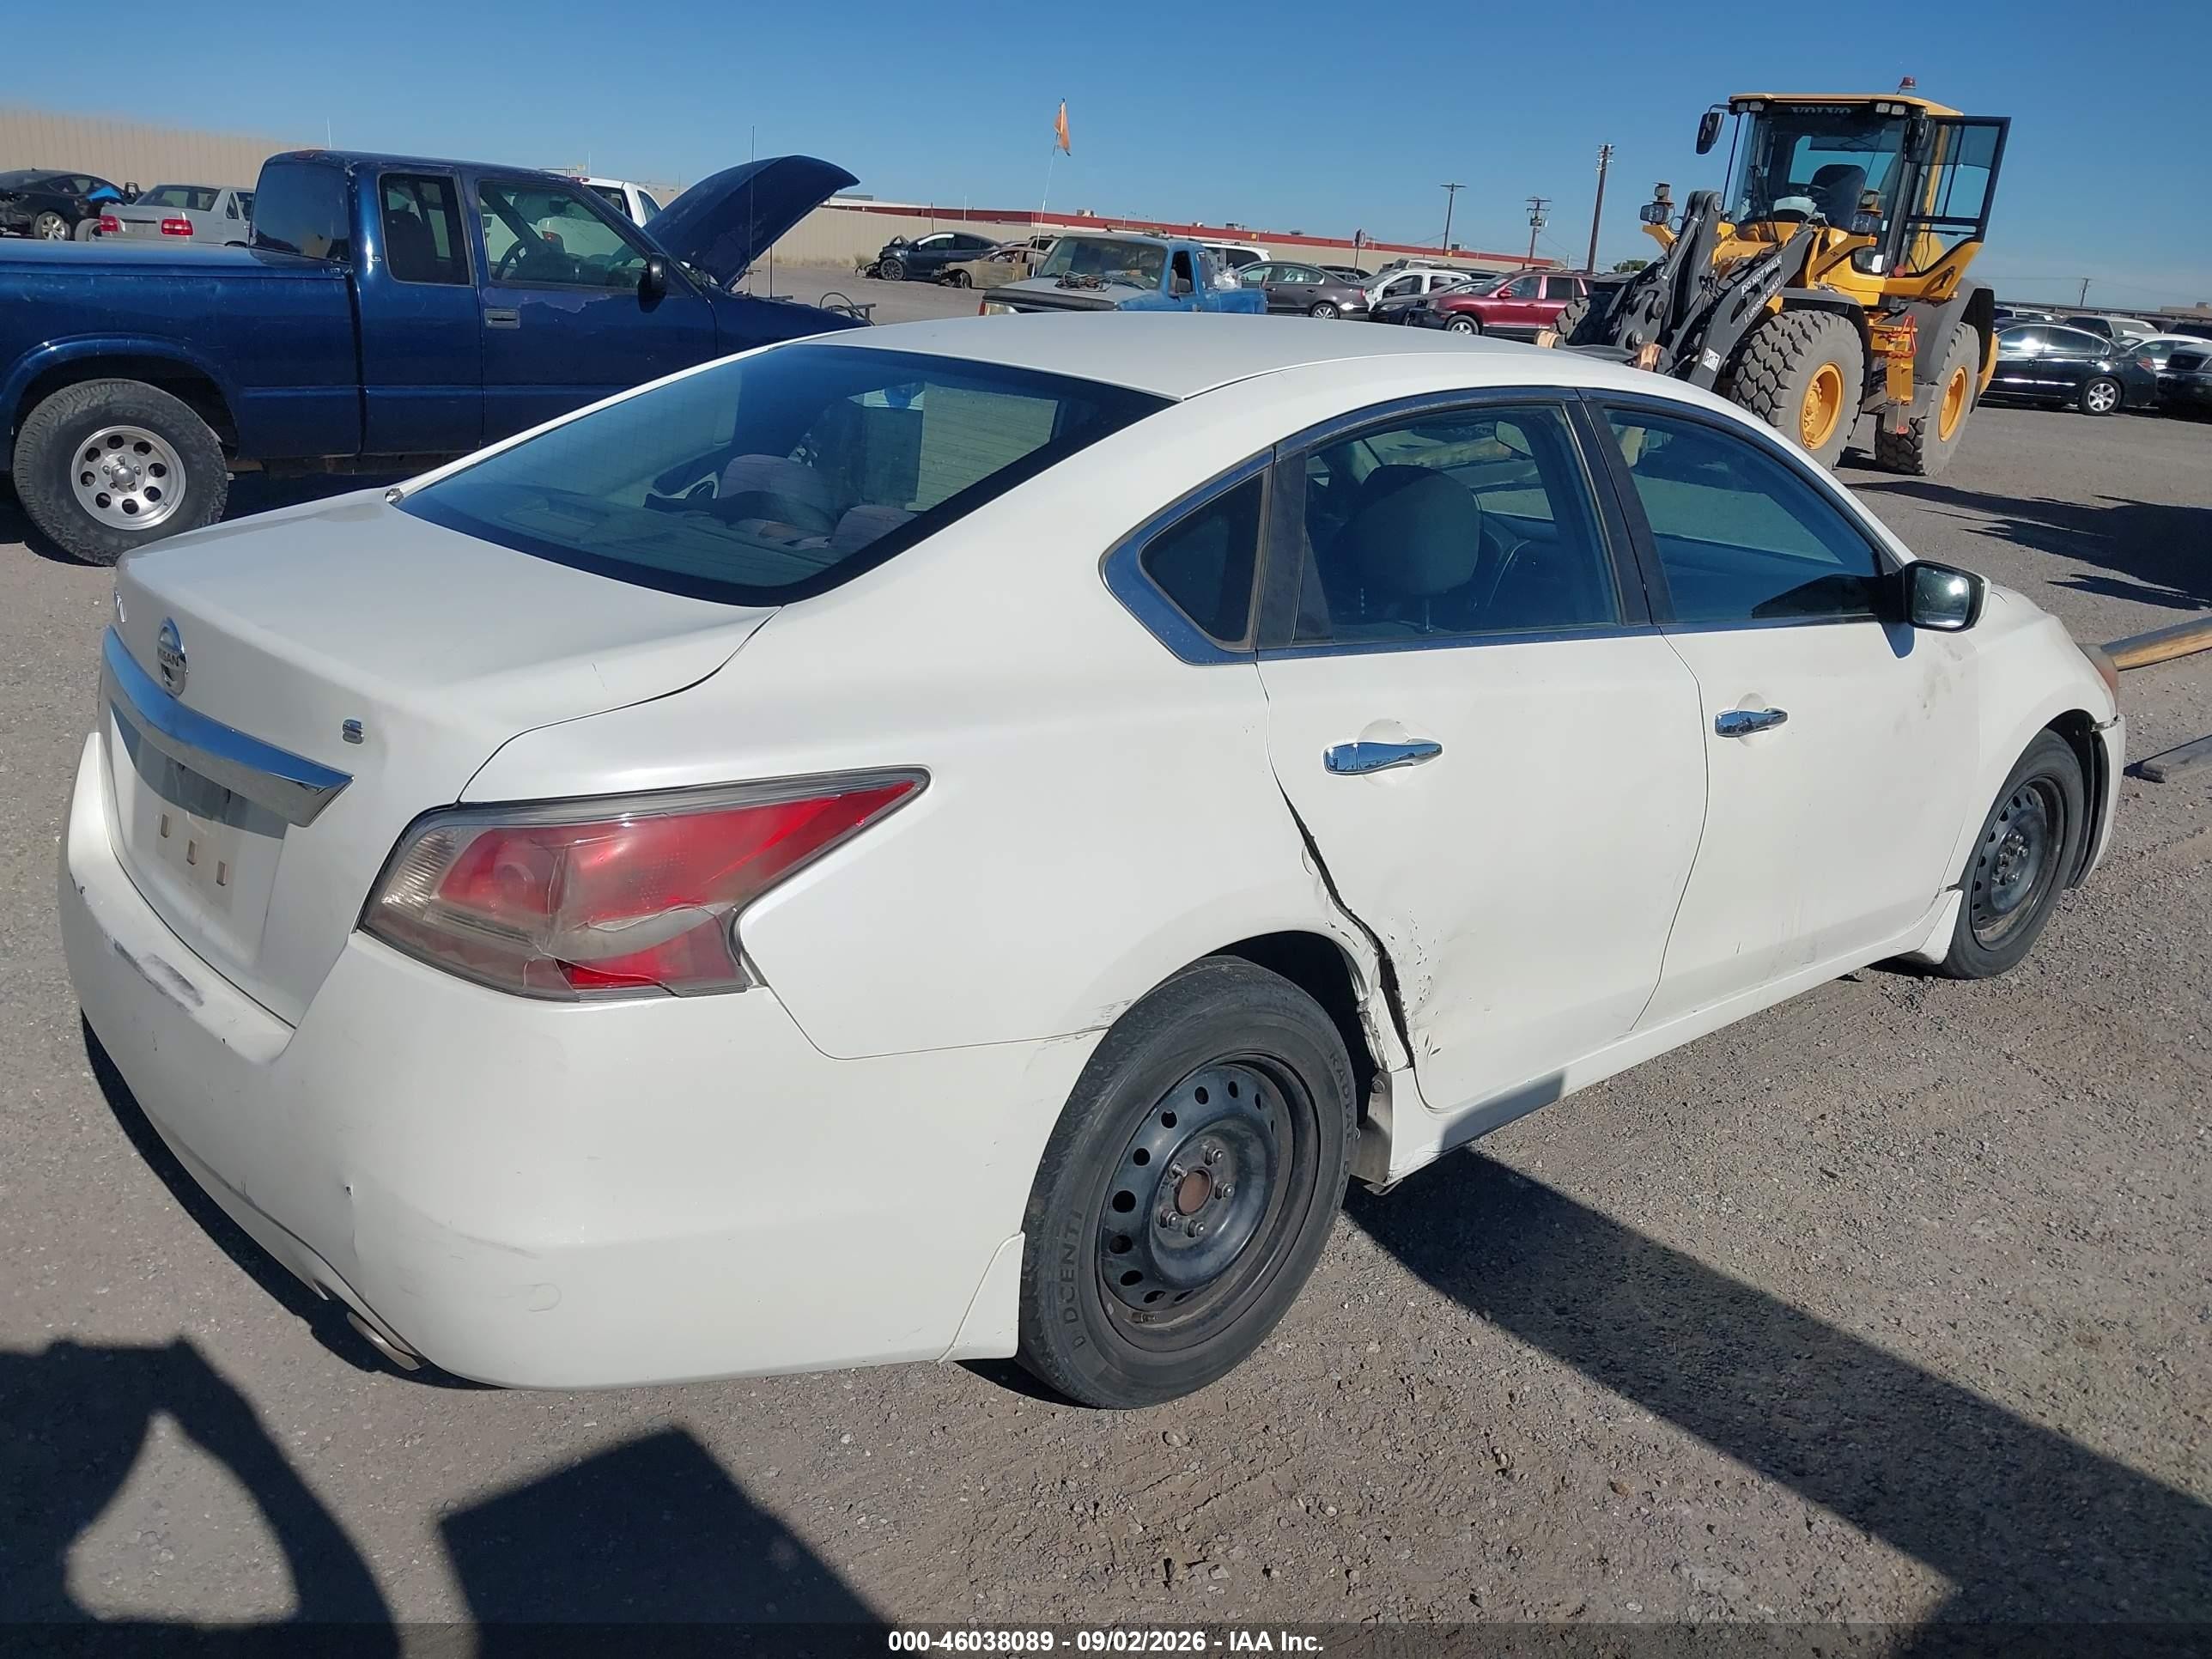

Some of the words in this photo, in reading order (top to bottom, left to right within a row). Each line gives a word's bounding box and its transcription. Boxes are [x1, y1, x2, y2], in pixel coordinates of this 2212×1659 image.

[1752, 270, 1765, 284] NOT
[1765, 258, 1781, 274] WALK
[1748, 294, 1767, 318] UNDER
[1767, 276, 1782, 295] MAST
[343, 719, 364, 744] S
